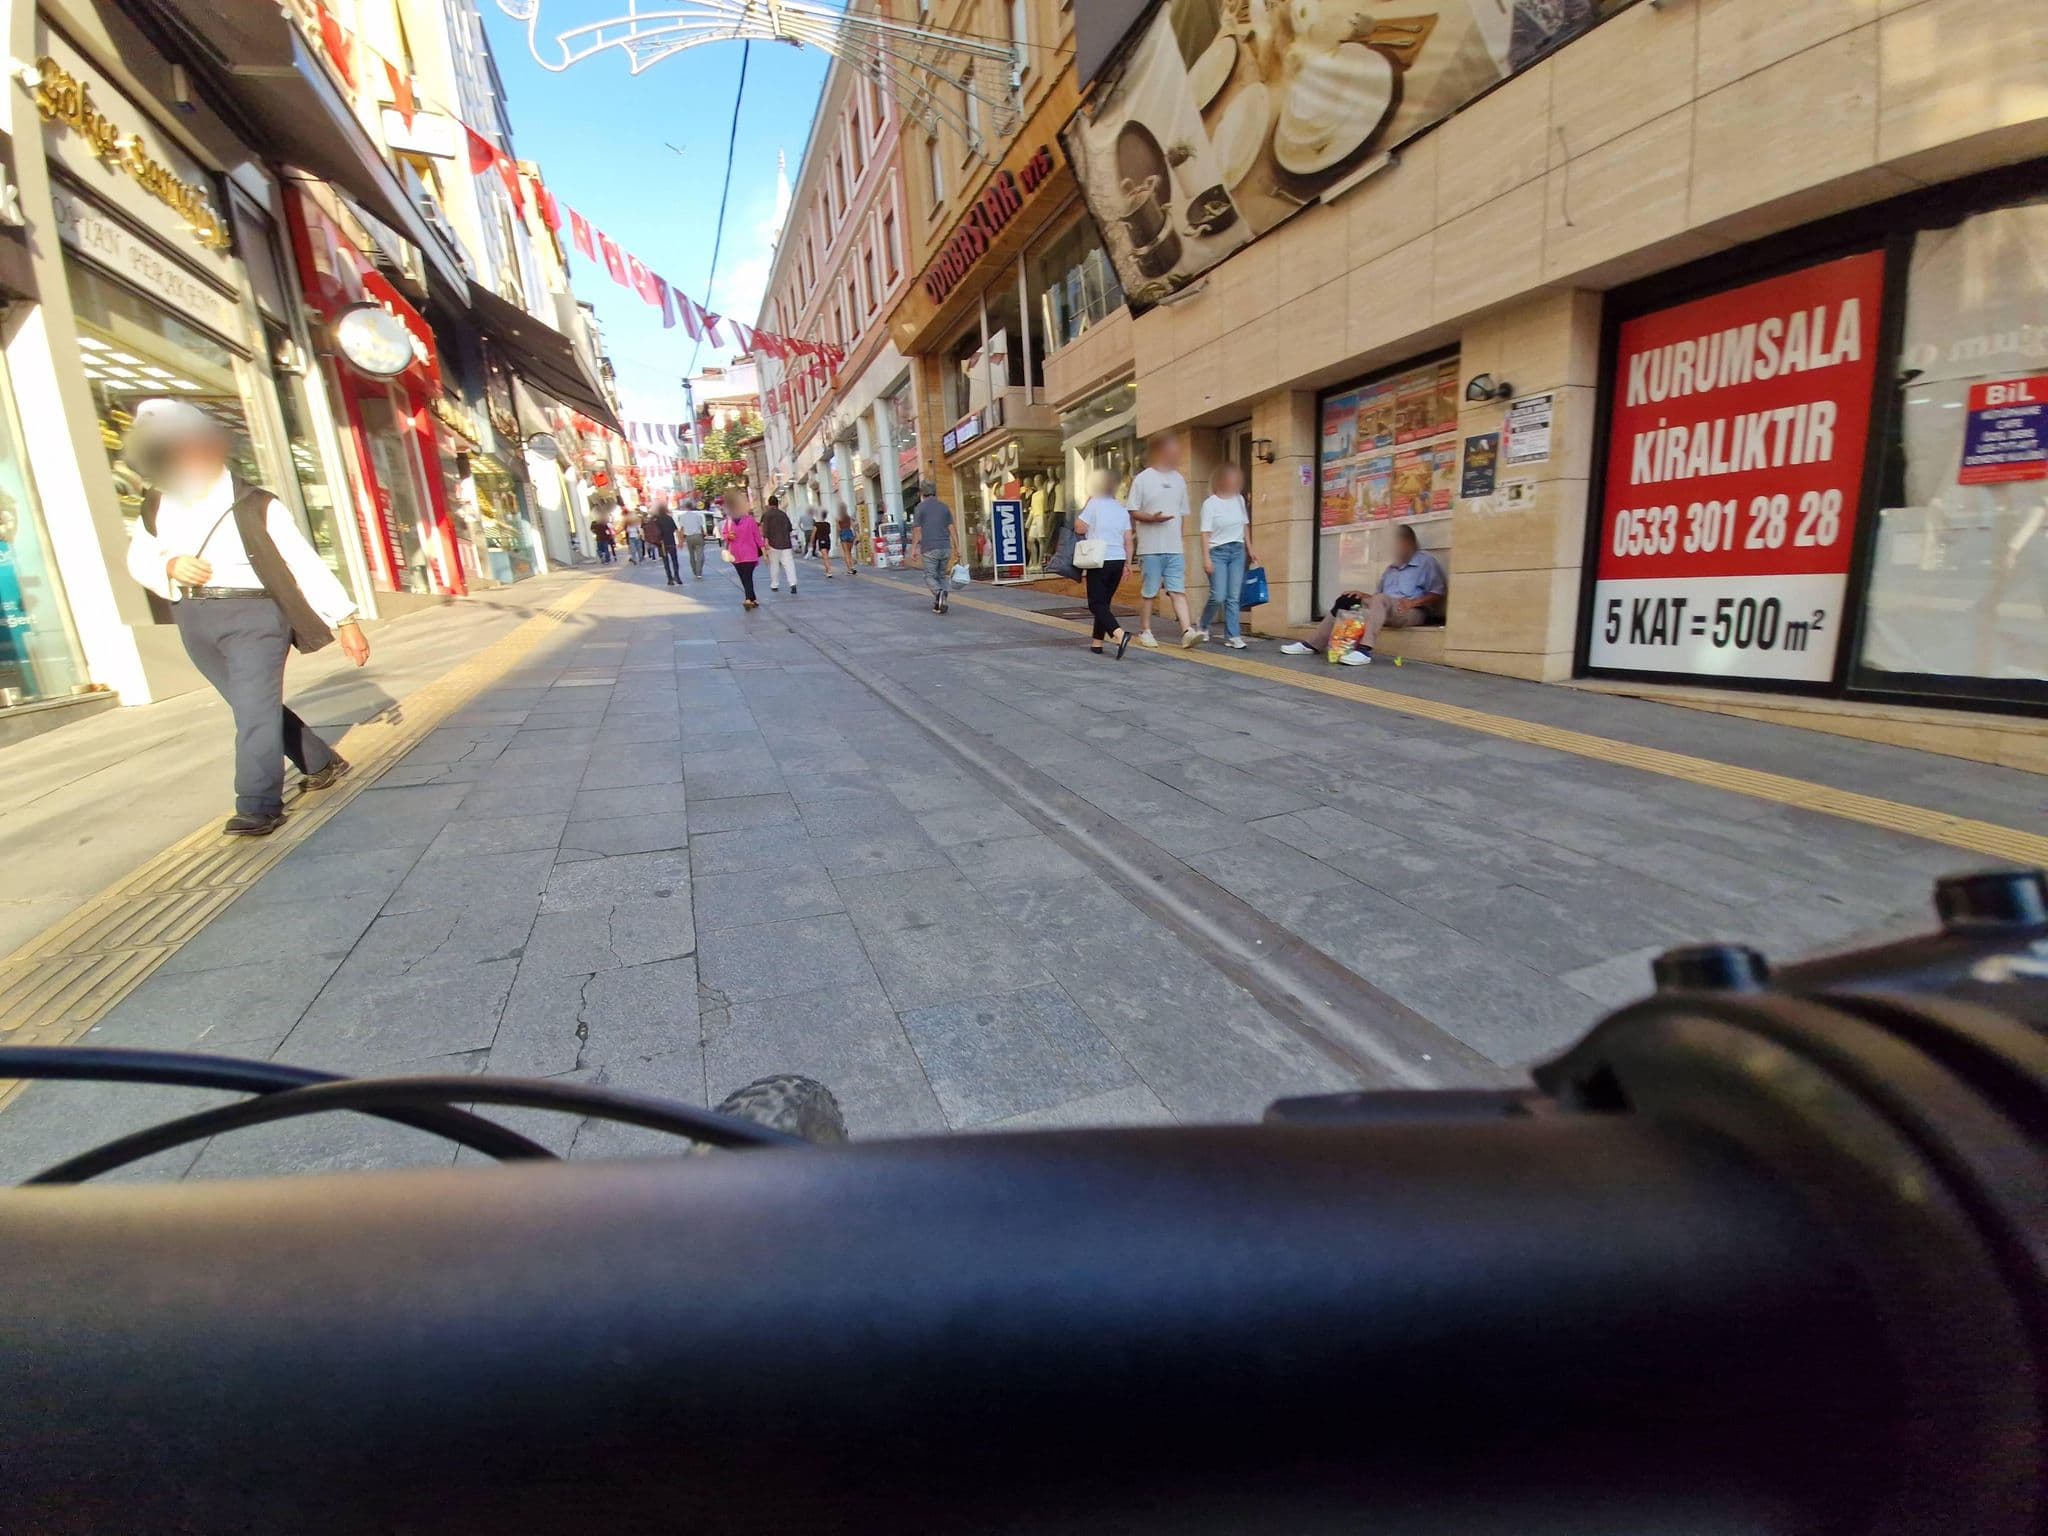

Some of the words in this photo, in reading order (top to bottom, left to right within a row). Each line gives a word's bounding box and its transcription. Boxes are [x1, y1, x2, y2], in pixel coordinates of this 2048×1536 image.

[1626, 297, 1861, 407] KURUMSALA
[1630, 399, 1837, 485] KİRALIKTIR
[996, 505, 1017, 561] mavi
[1613, 504, 1678, 558] 0533
[1683, 499, 1738, 554] 301
[1744, 492, 1790, 550] 28
[1793, 488, 1843, 547] 28
[1605, 598, 1622, 645] 5
[1629, 597, 1688, 646] KAT
[1712, 596, 1781, 650] 500
